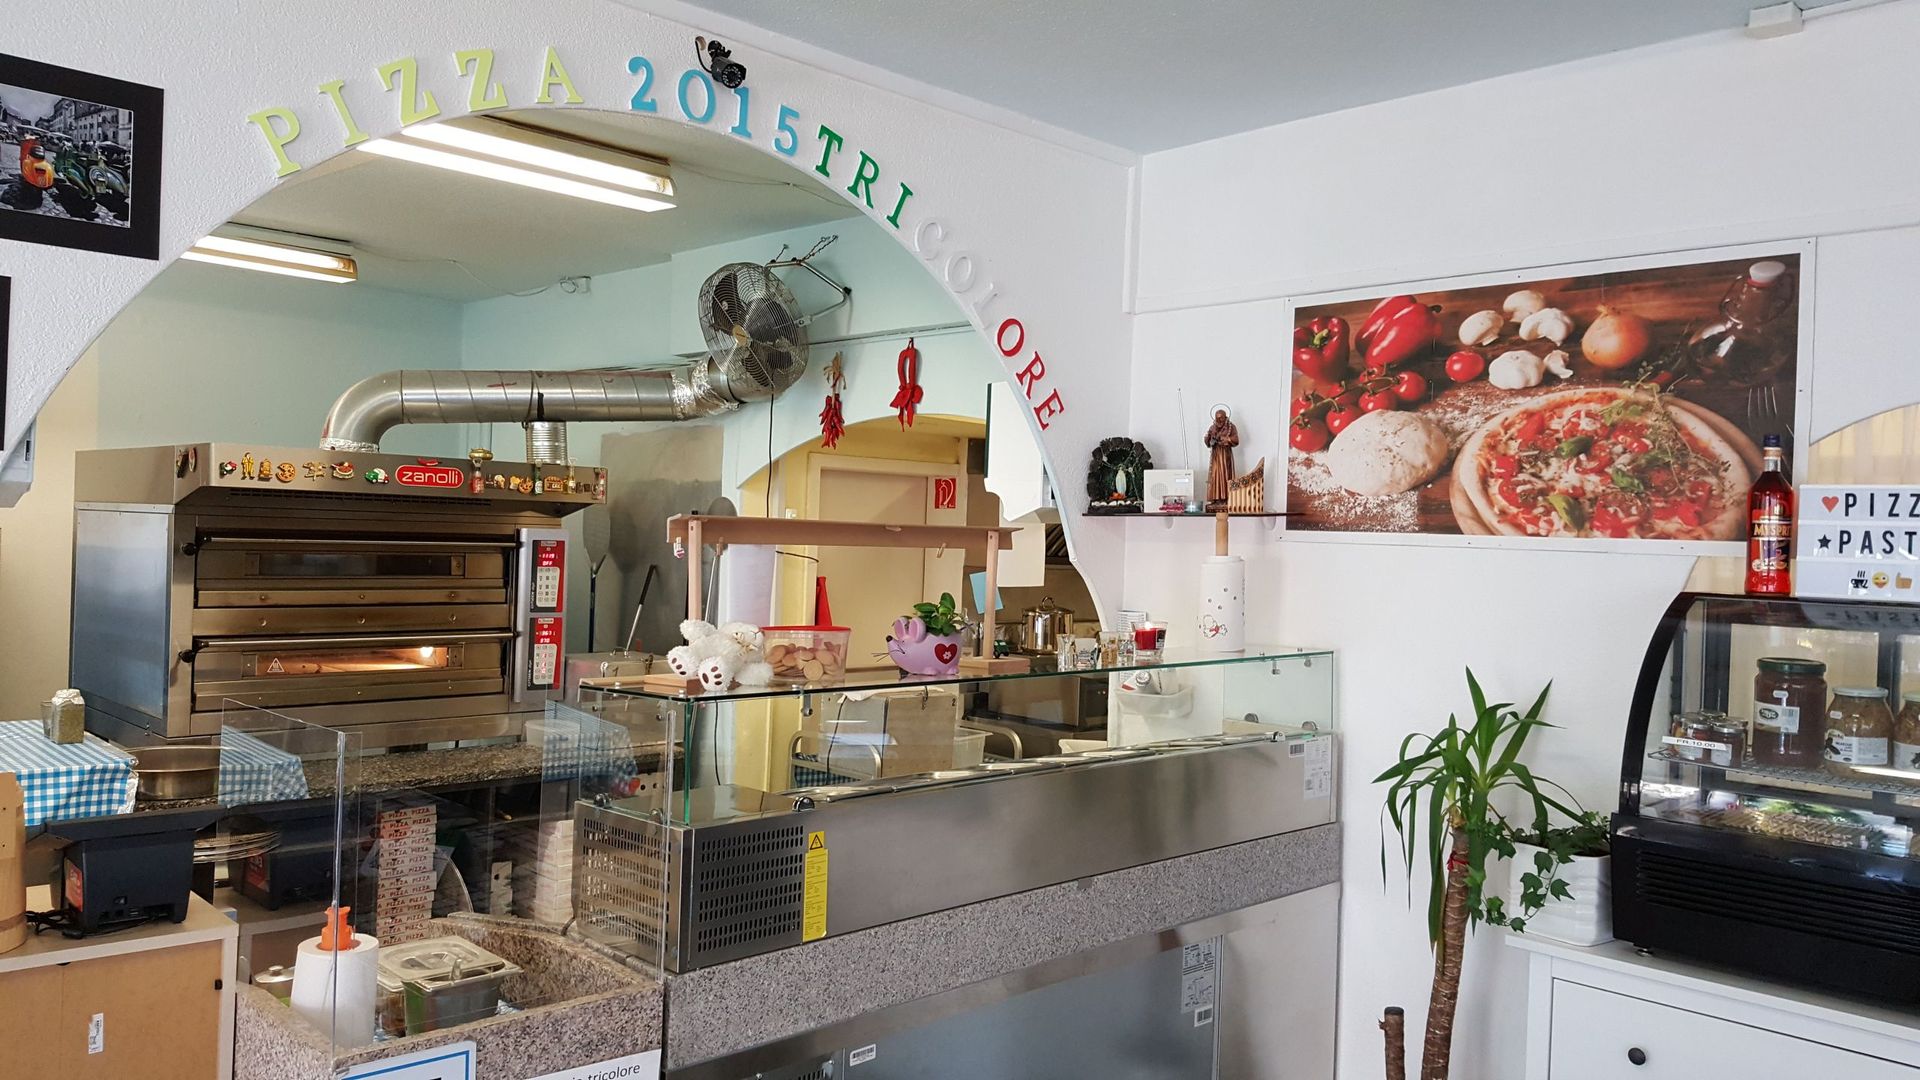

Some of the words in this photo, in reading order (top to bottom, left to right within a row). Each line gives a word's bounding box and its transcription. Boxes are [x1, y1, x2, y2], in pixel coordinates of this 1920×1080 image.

[248, 46, 584, 177] PIZZA
[627, 56, 800, 157] 2015
[814, 124, 1064, 431] TRICOLORE
[402, 471, 458, 485] zanolli
[1844, 493, 1920, 517] PIZZ
[1838, 530, 1917, 554] PAST
[412, 807, 430, 815] PIZZA
[588, 1064, 640, 1080] tricolore
